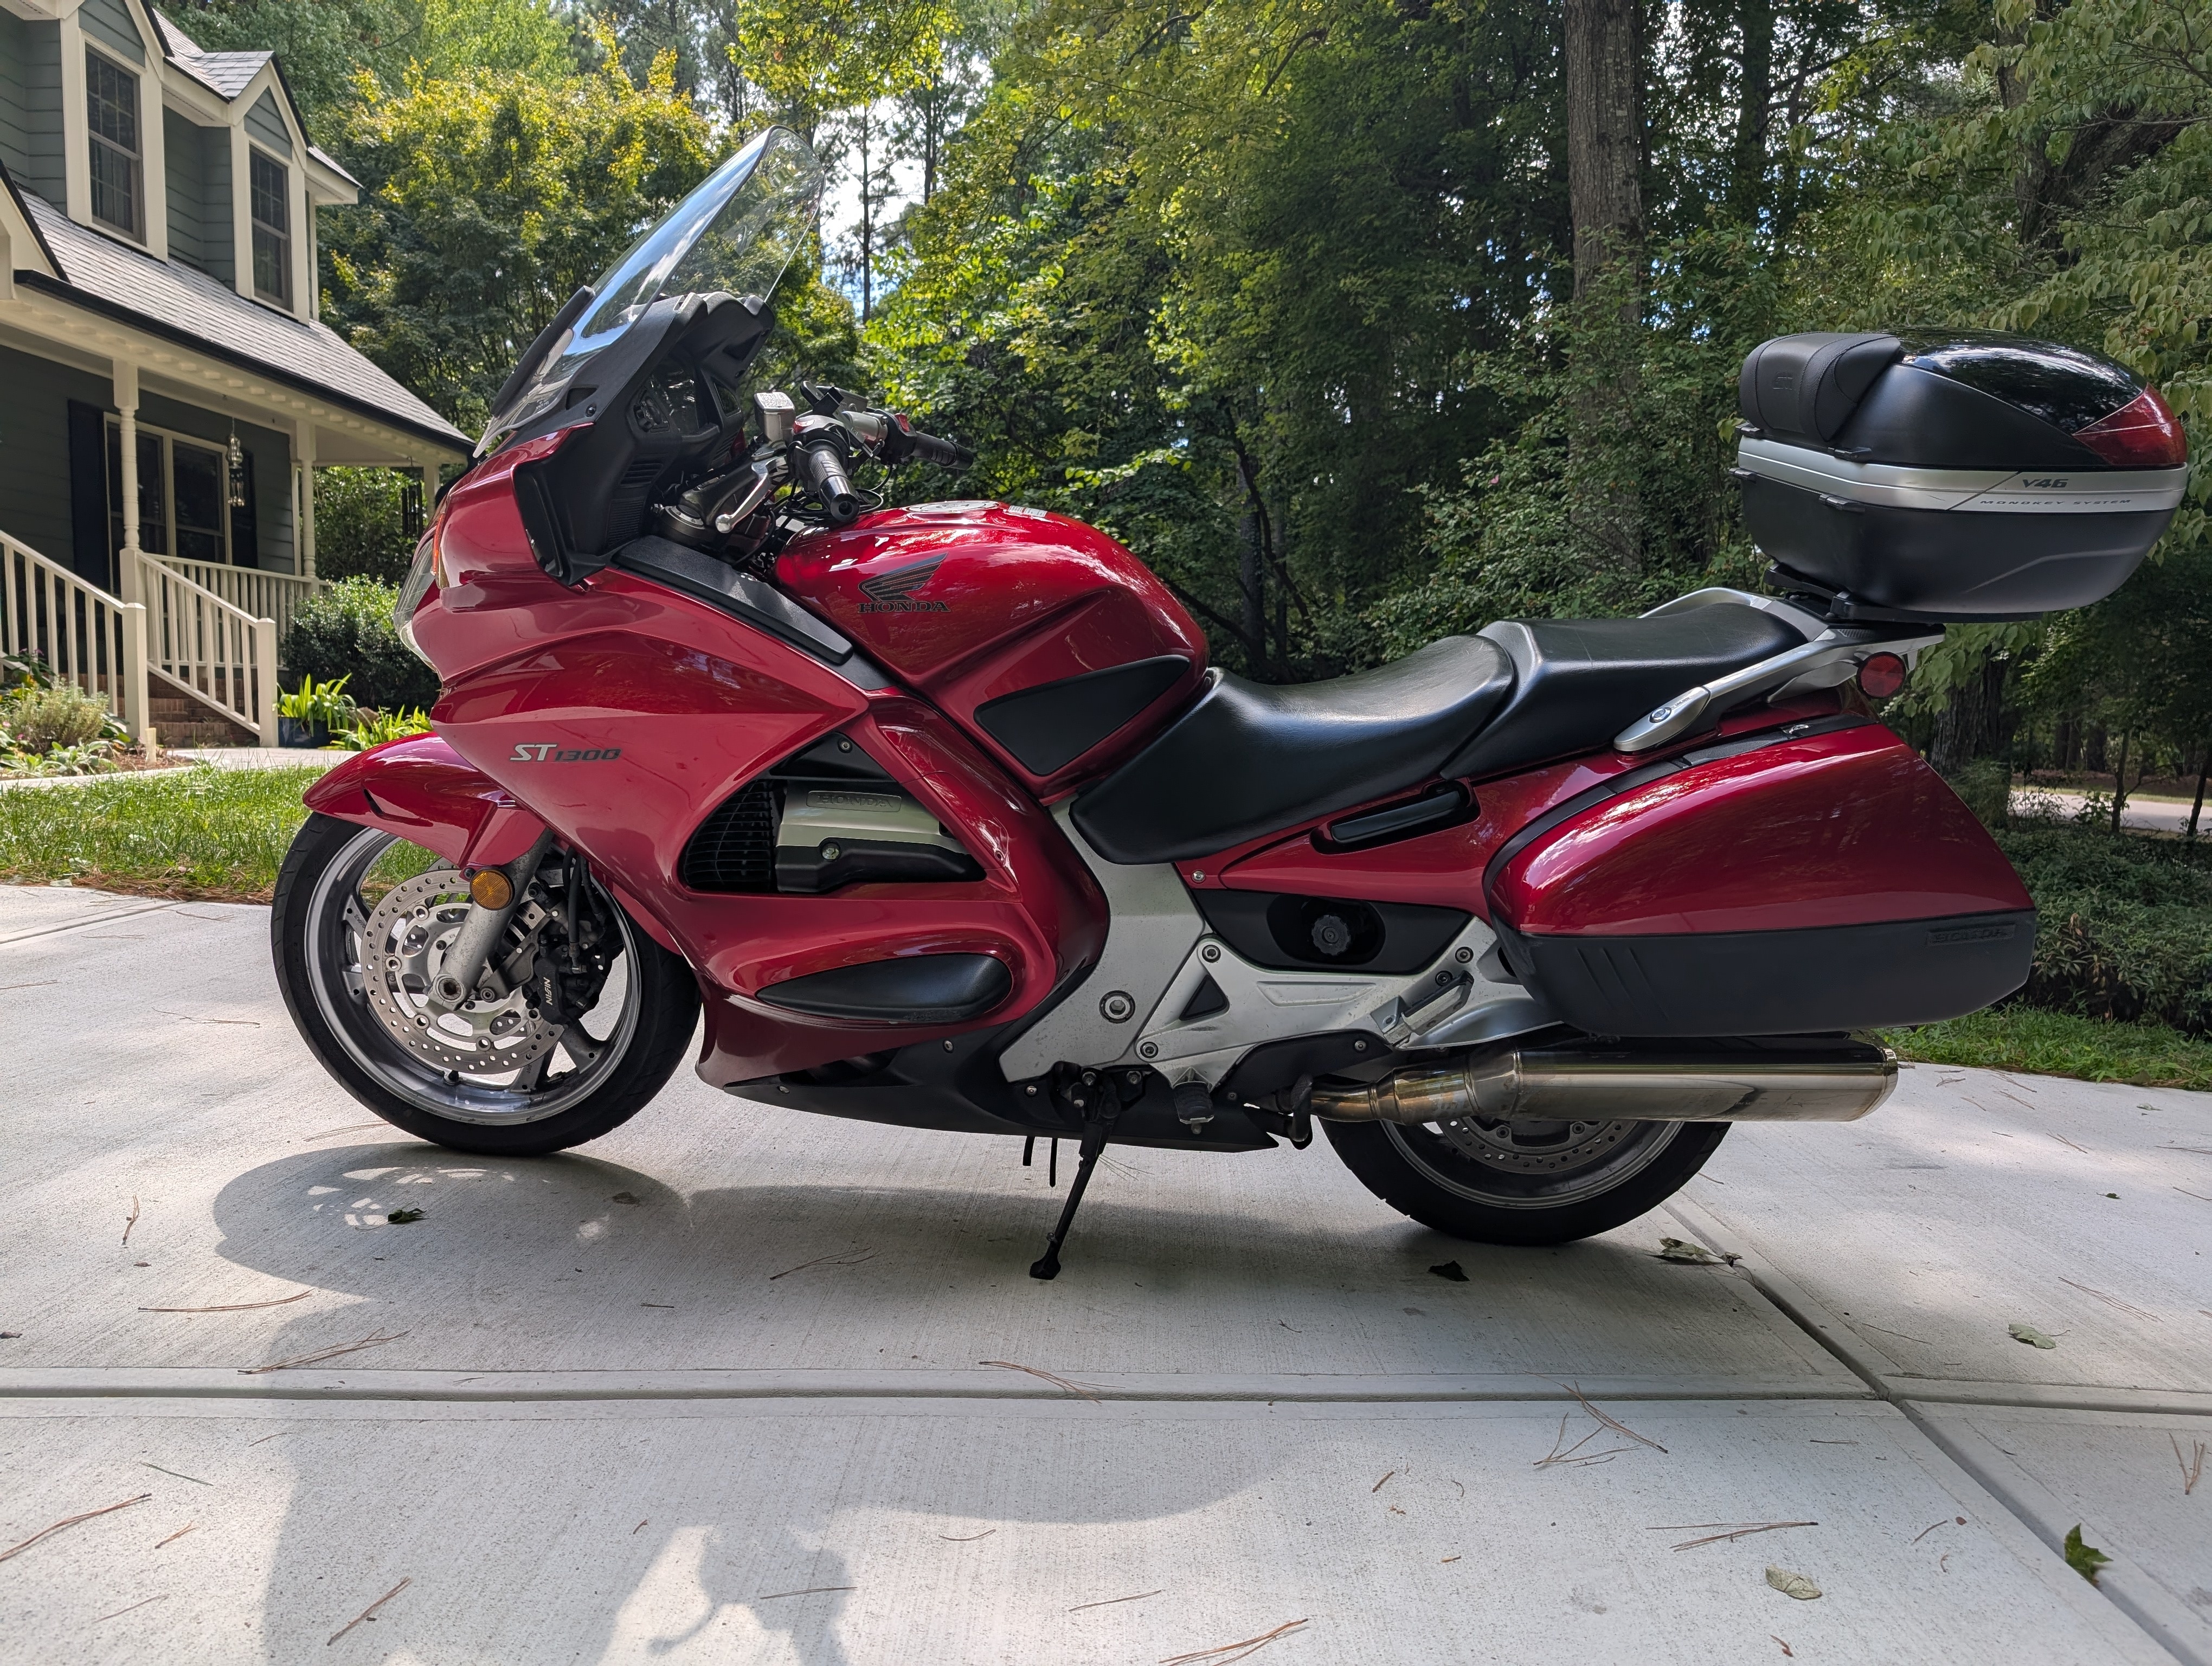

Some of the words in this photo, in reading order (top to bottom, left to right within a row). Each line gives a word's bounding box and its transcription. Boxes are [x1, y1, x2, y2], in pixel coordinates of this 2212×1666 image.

[2022, 478, 2069, 488] V46
[858, 601, 950, 613] HONDA
[816, 793, 893, 808] HONDA
